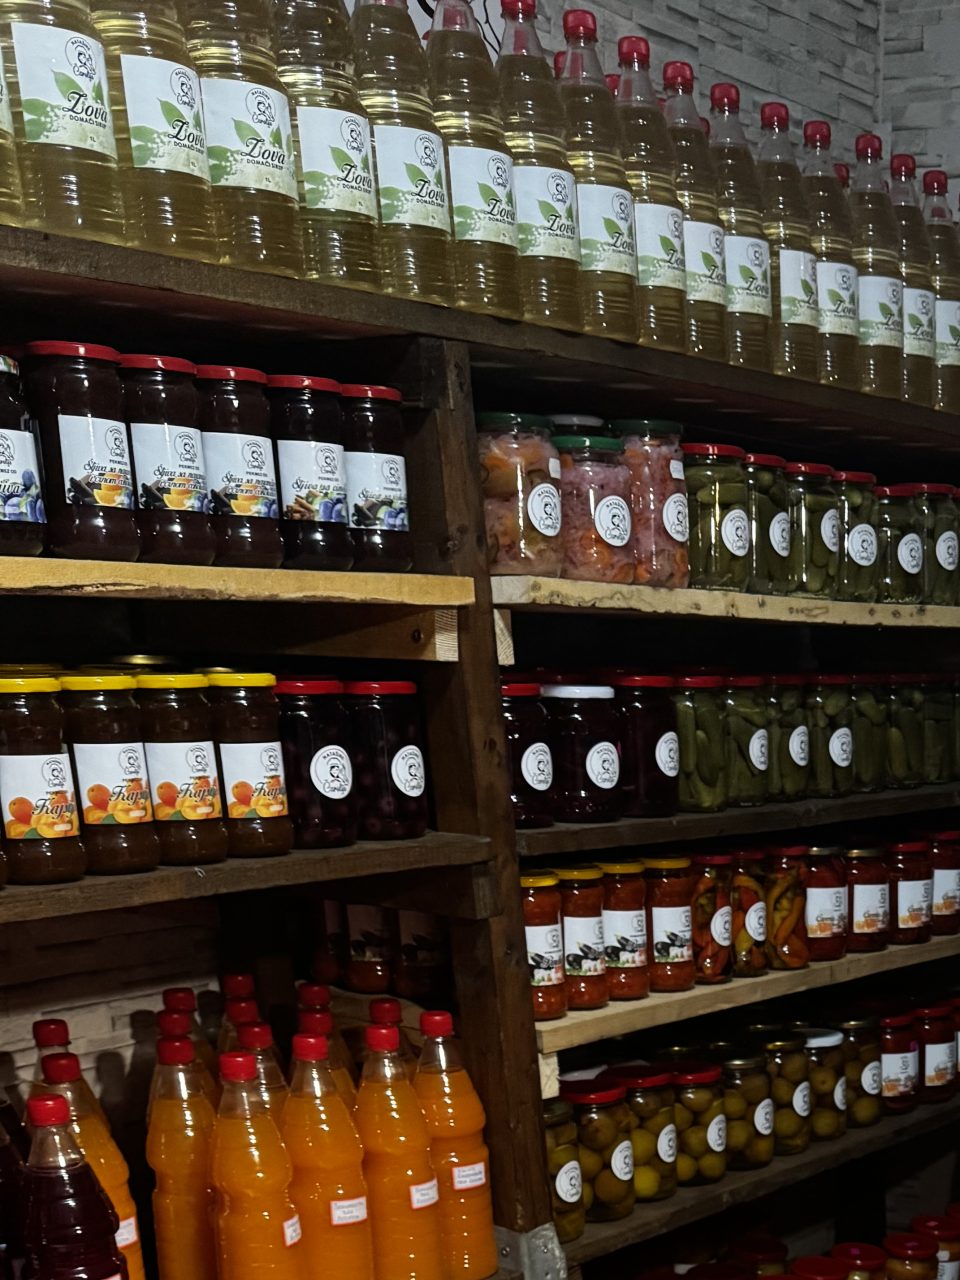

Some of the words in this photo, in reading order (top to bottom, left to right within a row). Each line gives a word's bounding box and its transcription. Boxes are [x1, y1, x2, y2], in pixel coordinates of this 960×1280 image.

[62, 91, 107, 123] Zova
[168, 119, 205, 149] Zova
[240, 137, 286, 164] Zova
[337, 163, 372, 189] Zova
[410, 179, 445, 203] Zova
